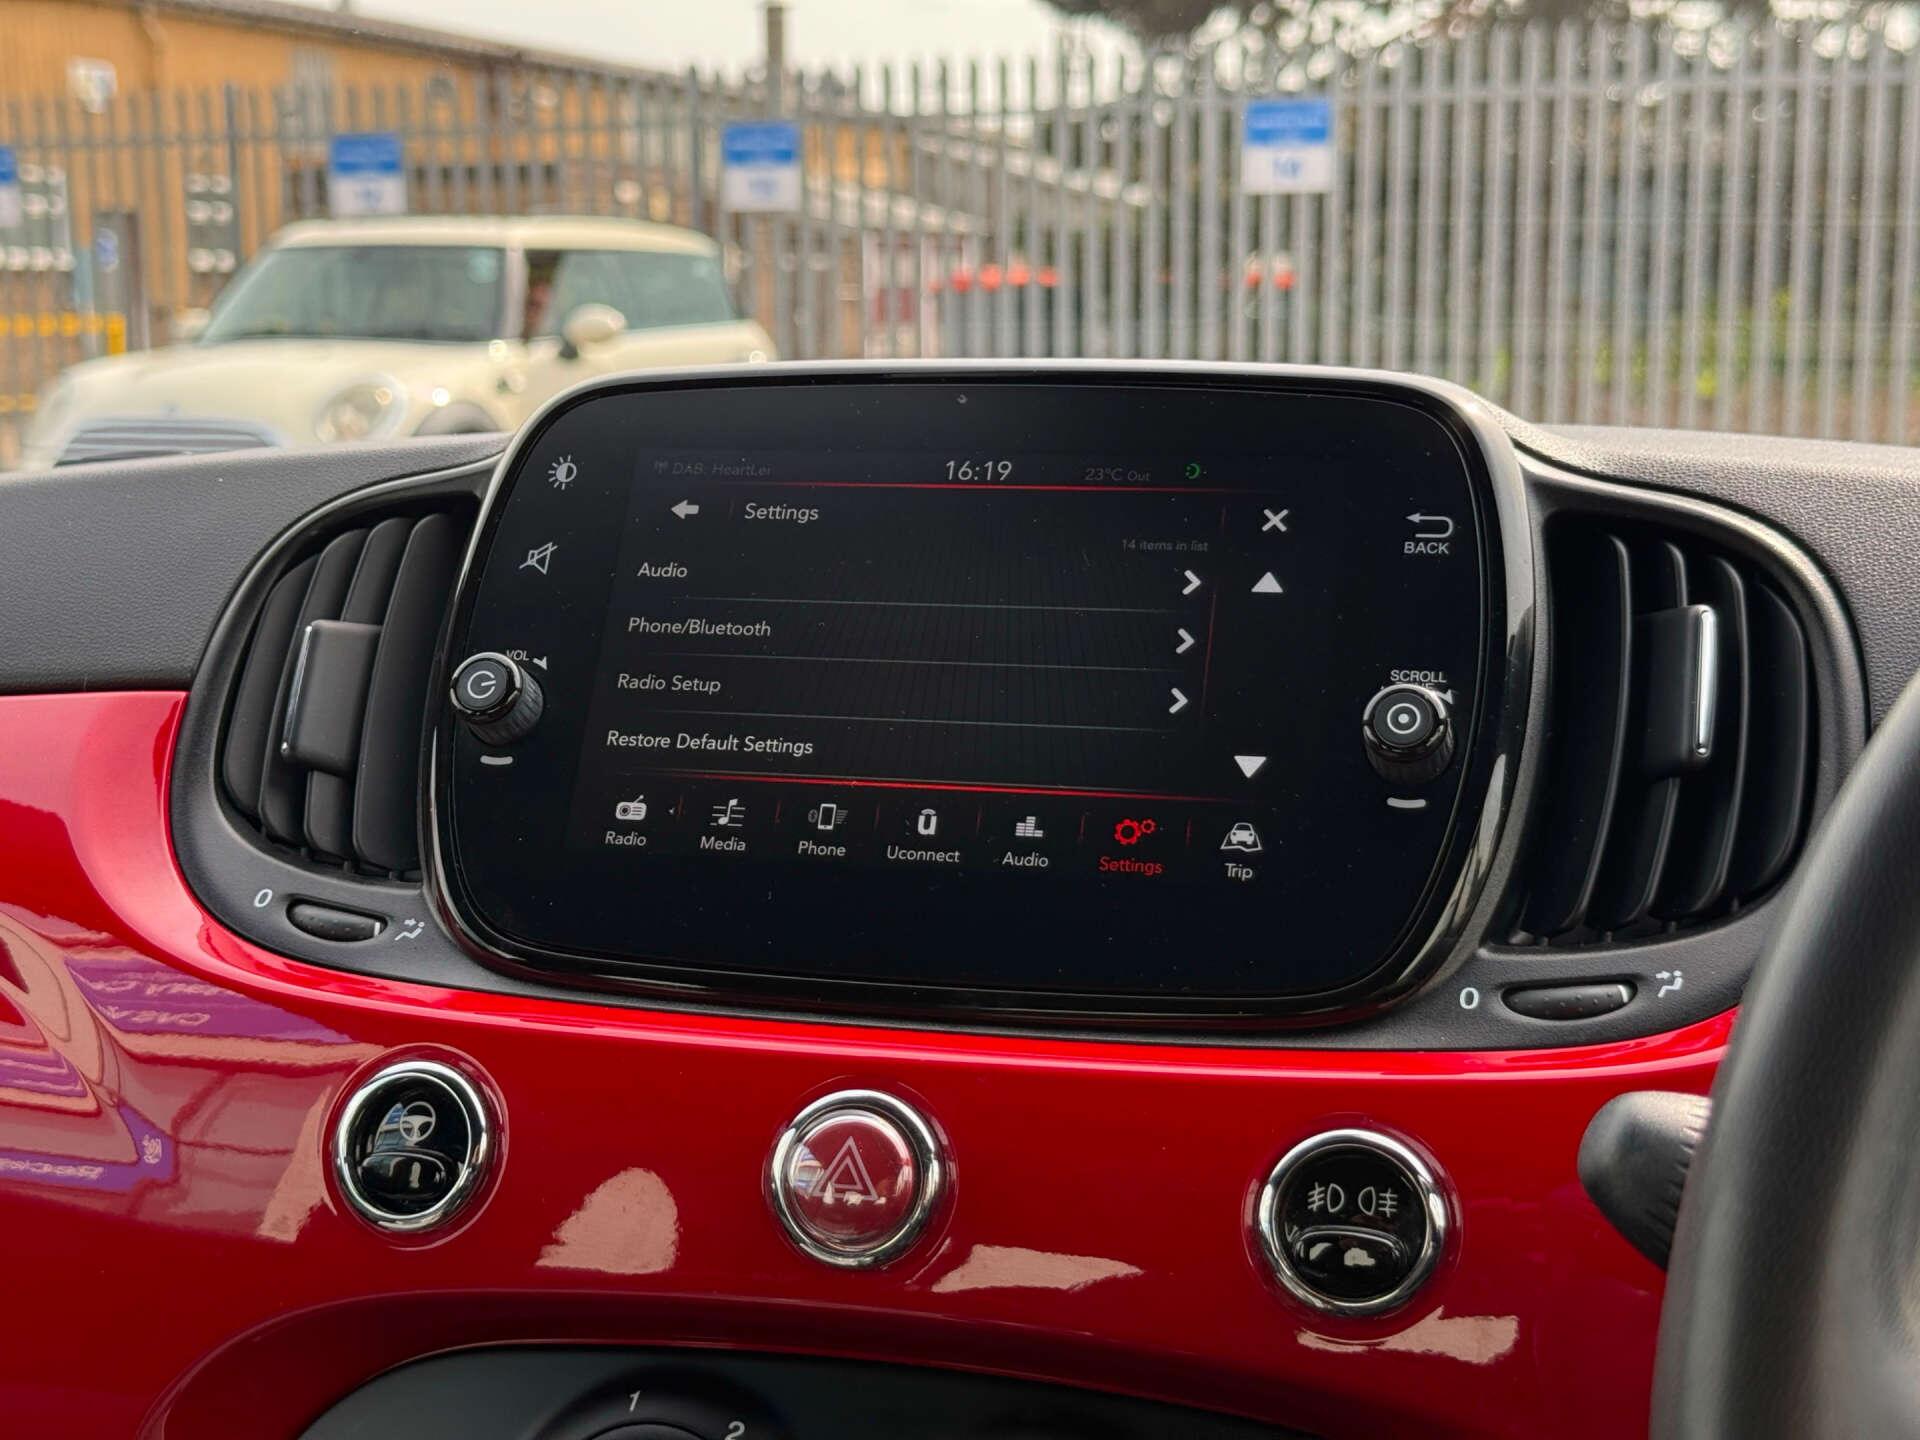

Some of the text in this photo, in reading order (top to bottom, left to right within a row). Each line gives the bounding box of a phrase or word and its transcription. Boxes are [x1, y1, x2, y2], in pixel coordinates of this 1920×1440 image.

[945, 460, 1013, 481] 16:19
[1127, 470, 1151, 482] Out
[744, 502, 819, 524] Settings
[1122, 539, 1209, 552] 14 items in list
[1403, 541, 1449, 555] BACK
[637, 561, 688, 578] Audio
[628, 616, 771, 637] Phone/Bluetooth
[506, 650, 531, 662] VOL
[617, 673, 721, 693] Radio Setup
[1390, 669, 1447, 683] SCROLL
[606, 730, 813, 757] Restore Default Settings
[604, 830, 647, 847] Radio
[699, 835, 746, 852] Media
[797, 840, 846, 857] Phone
[886, 845, 961, 863] Uconnect
[1002, 851, 1049, 868] Audio
[1099, 856, 1163, 876] Settings
[1224, 862, 1253, 881] Trip
[1459, 987, 1480, 1010] 0
[629, 1390, 641, 1412] 1
[724, 1420, 746, 1440] 2
